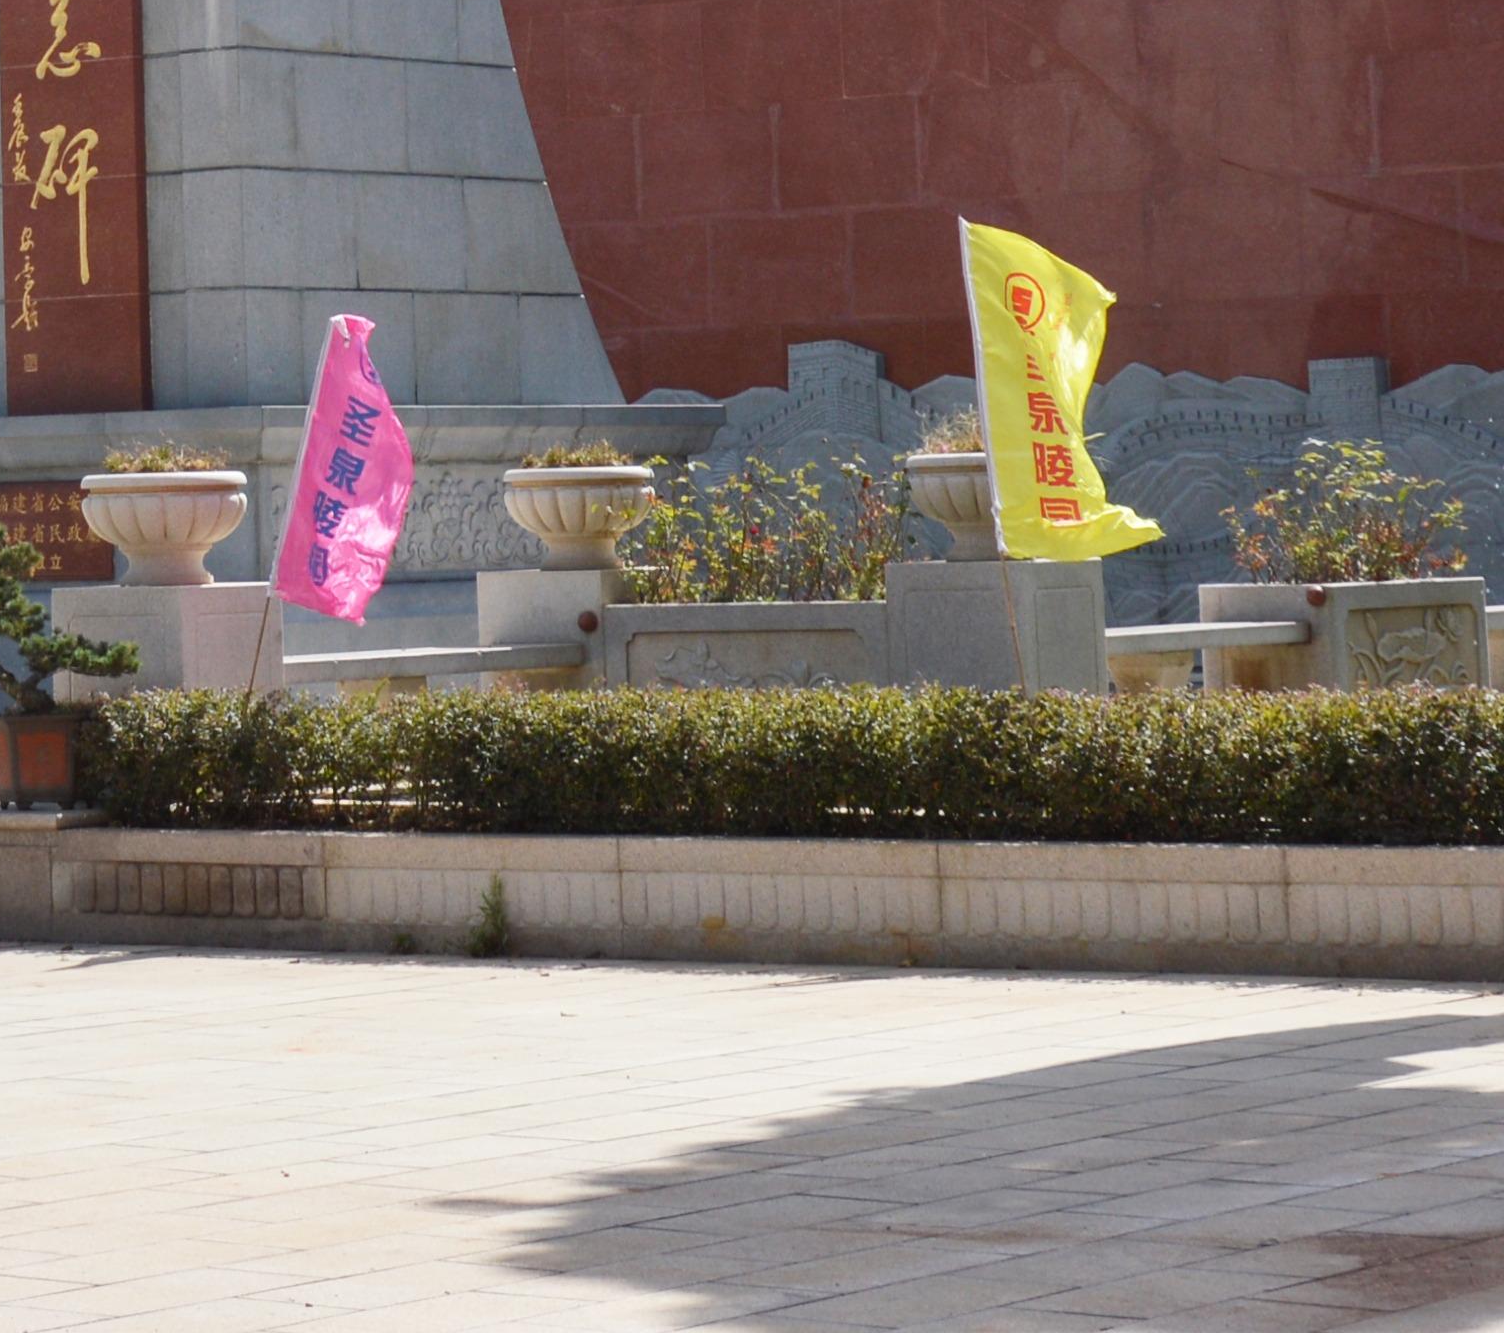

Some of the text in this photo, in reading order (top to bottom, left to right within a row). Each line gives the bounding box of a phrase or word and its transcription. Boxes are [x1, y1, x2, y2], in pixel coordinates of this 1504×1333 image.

[12, 522, 101, 544] 建省民政
[309, 395, 382, 586] 圣泉陵园
